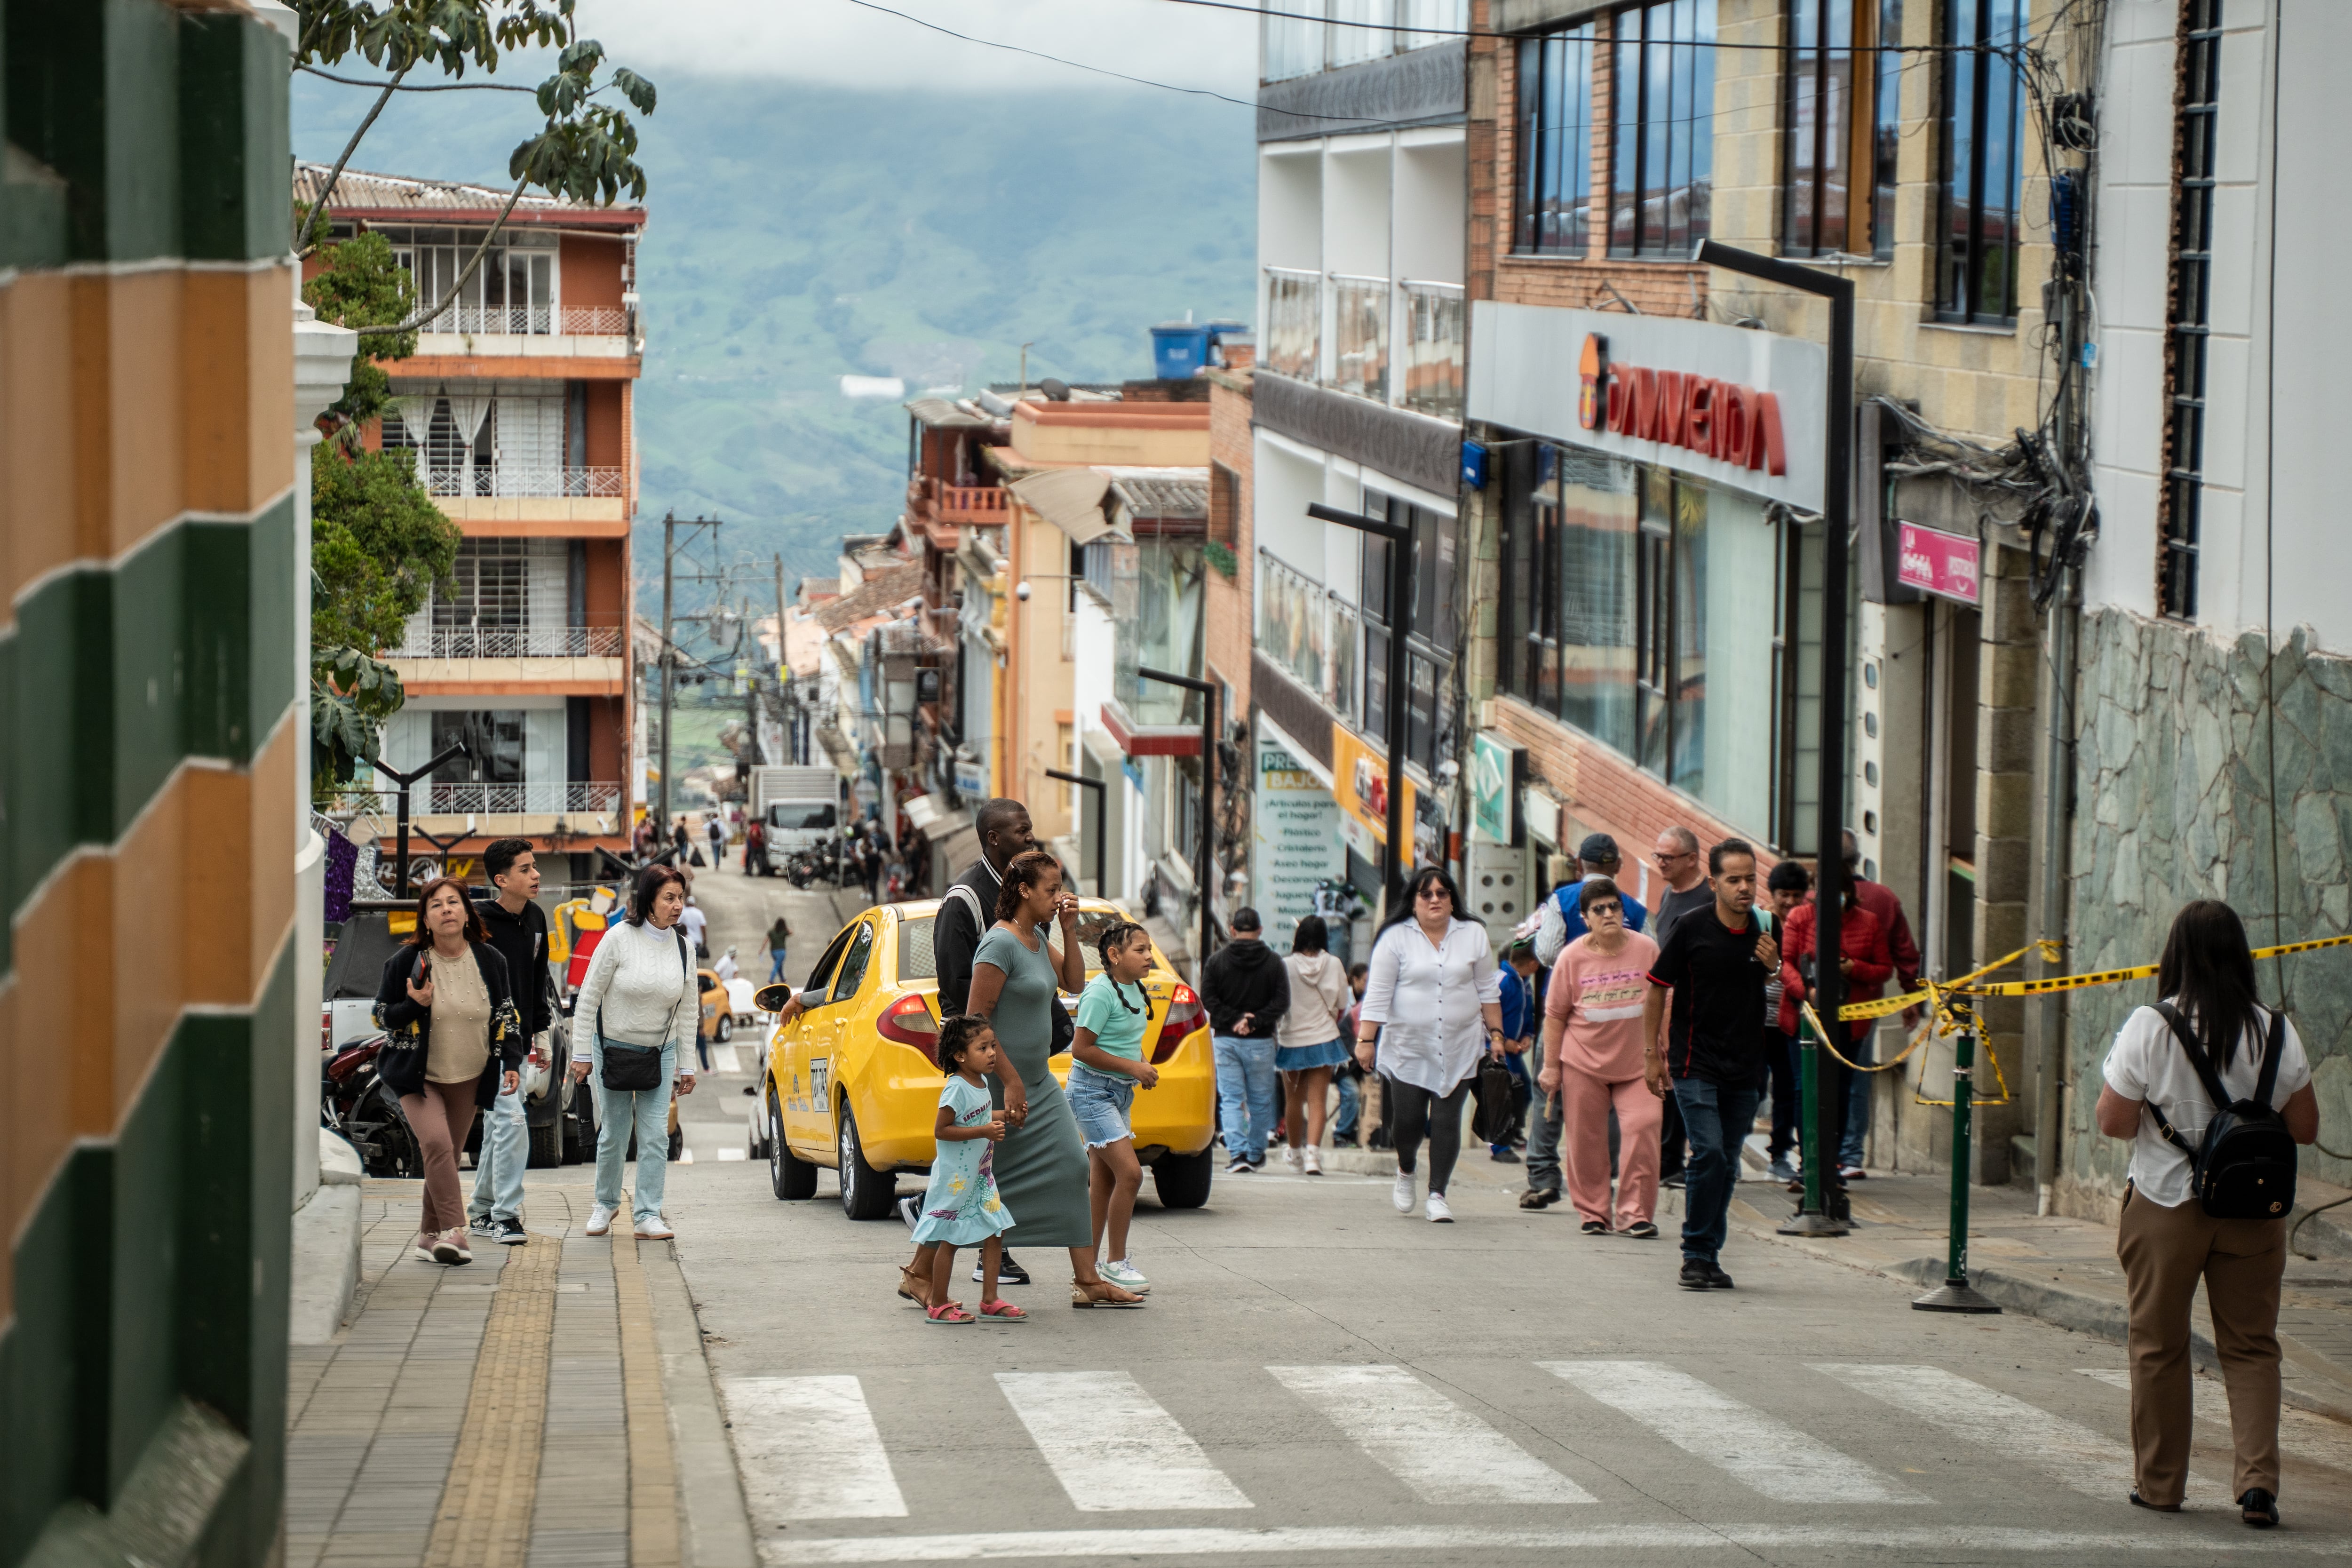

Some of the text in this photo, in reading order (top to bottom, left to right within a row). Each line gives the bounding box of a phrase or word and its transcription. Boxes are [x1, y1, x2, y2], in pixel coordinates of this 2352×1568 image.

[1271, 772, 1324, 788] BAJO
[1313, 800, 1337, 809] para
[1275, 890, 1314, 900] Juguete
